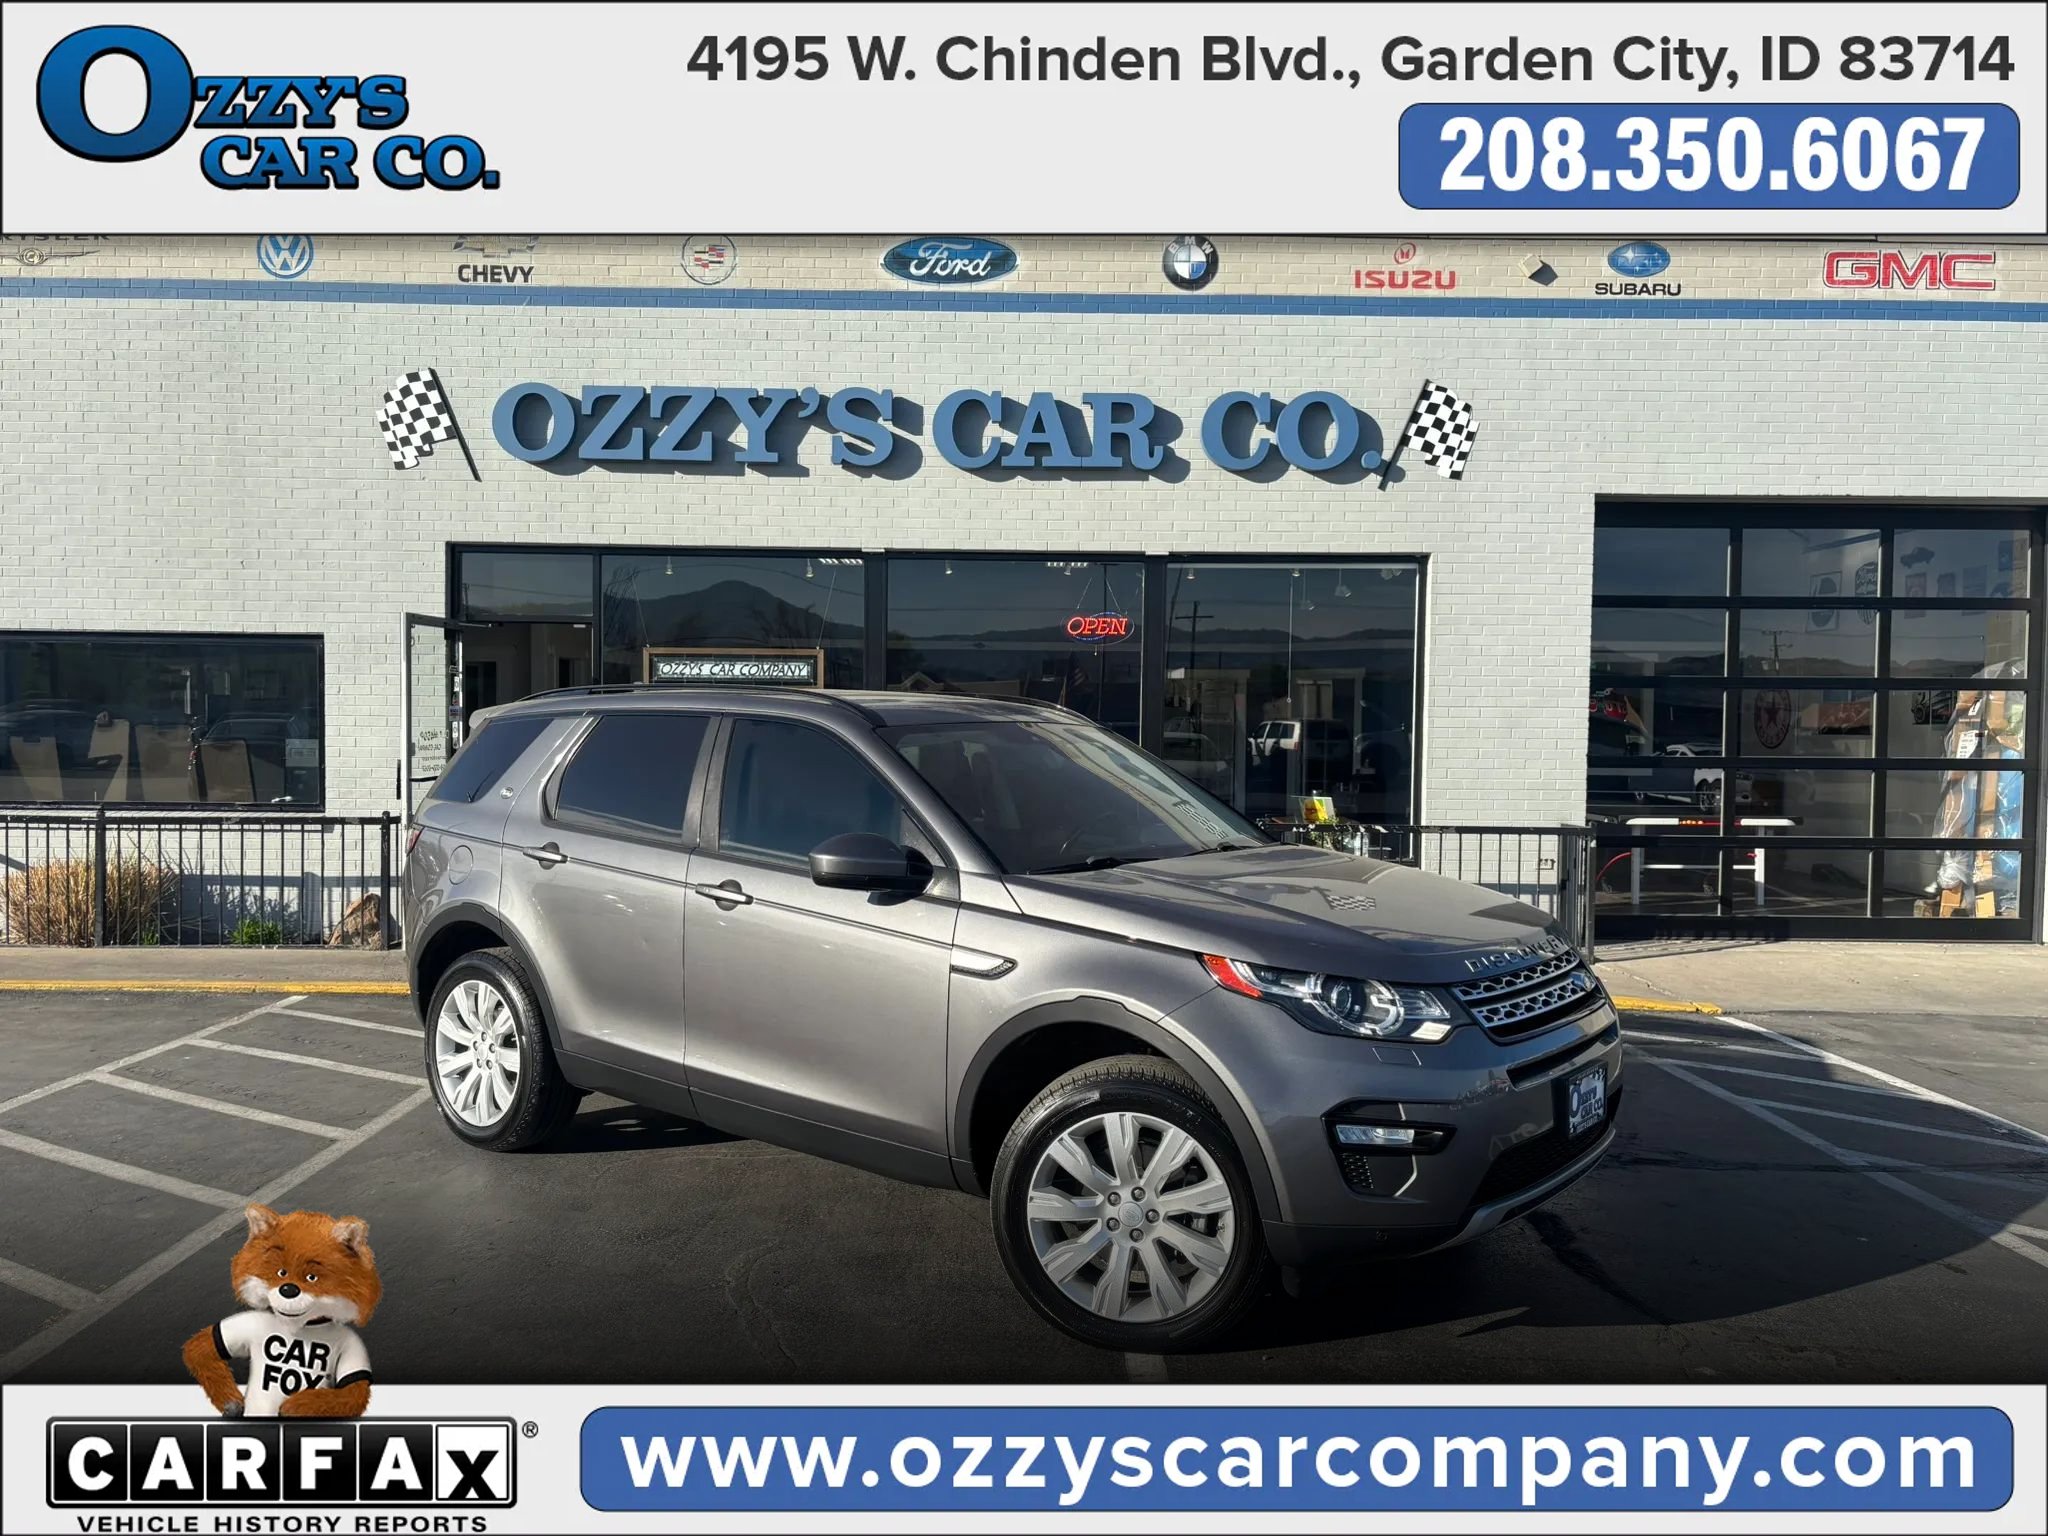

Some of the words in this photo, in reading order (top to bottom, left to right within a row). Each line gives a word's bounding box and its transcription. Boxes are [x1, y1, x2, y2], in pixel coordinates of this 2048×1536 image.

[1168, 236, 1213, 254] BMW
[910, 242, 992, 276] Ford
[458, 264, 534, 283] CHEVY
[1354, 269, 1456, 290] ISUZU
[1824, 251, 1995, 290] GMC
[1595, 283, 1681, 296] SUBARU
[493, 382, 893, 467] OZZY'S
[932, 389, 1164, 470] CAR
[1200, 390, 1381, 471] CO.
[1067, 616, 1128, 635] OPEN
[709, 663, 734, 676] CAR
[739, 664, 806, 677] COMPANY
